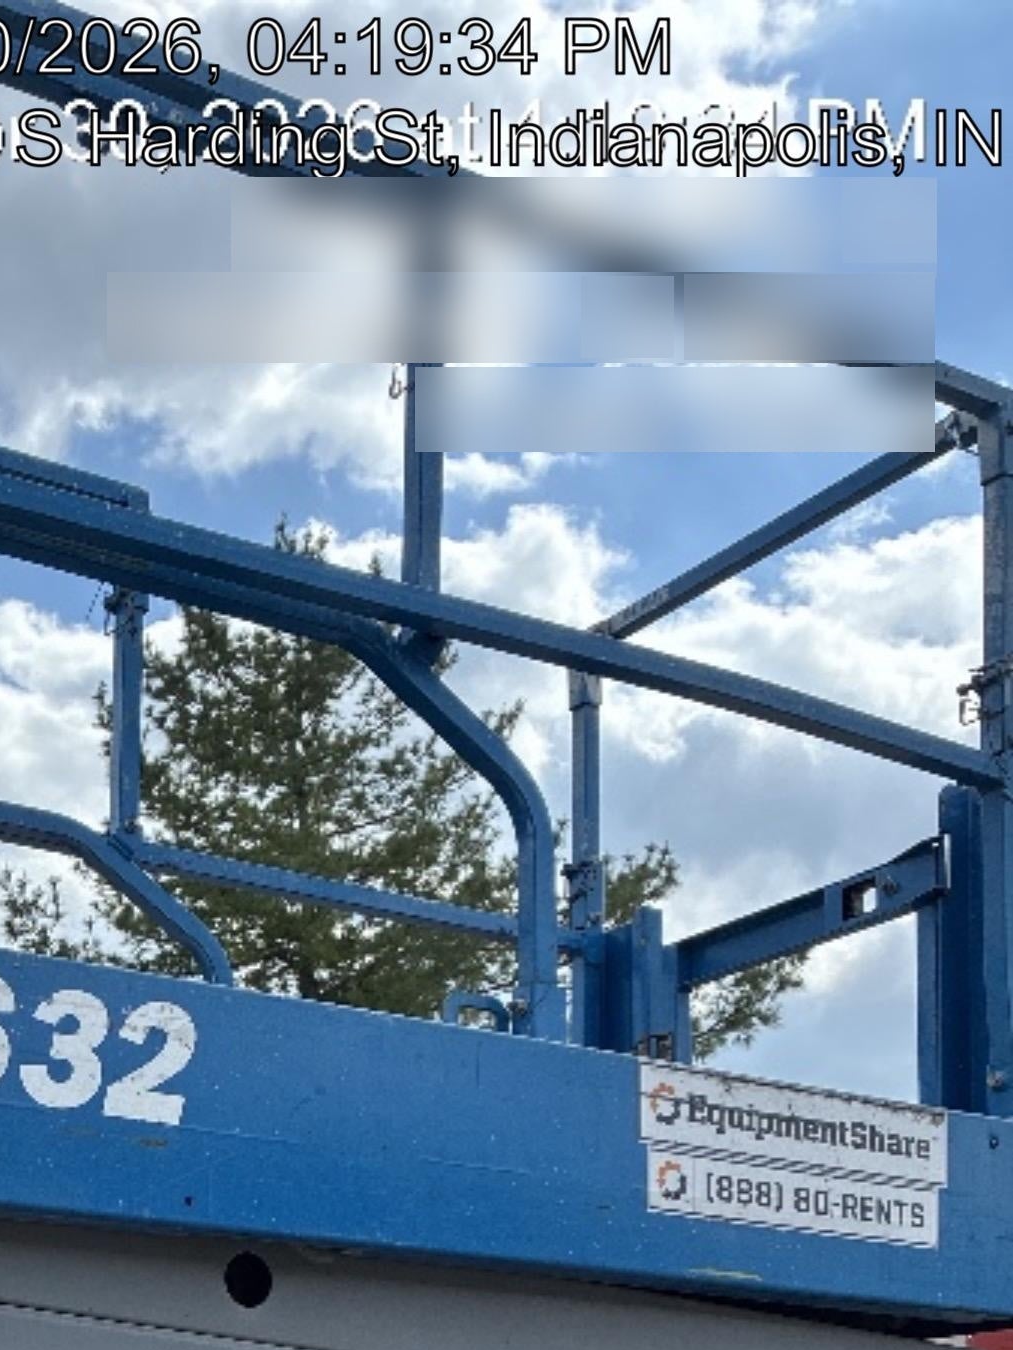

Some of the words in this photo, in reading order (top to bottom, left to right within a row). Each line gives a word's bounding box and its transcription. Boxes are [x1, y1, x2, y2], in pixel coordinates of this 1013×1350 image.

[688, 1093, 931, 1160] EquipmentShare
[705, 1171, 784, 1213] (888)
[793, 1186, 925, 1229] 80-RENTS
